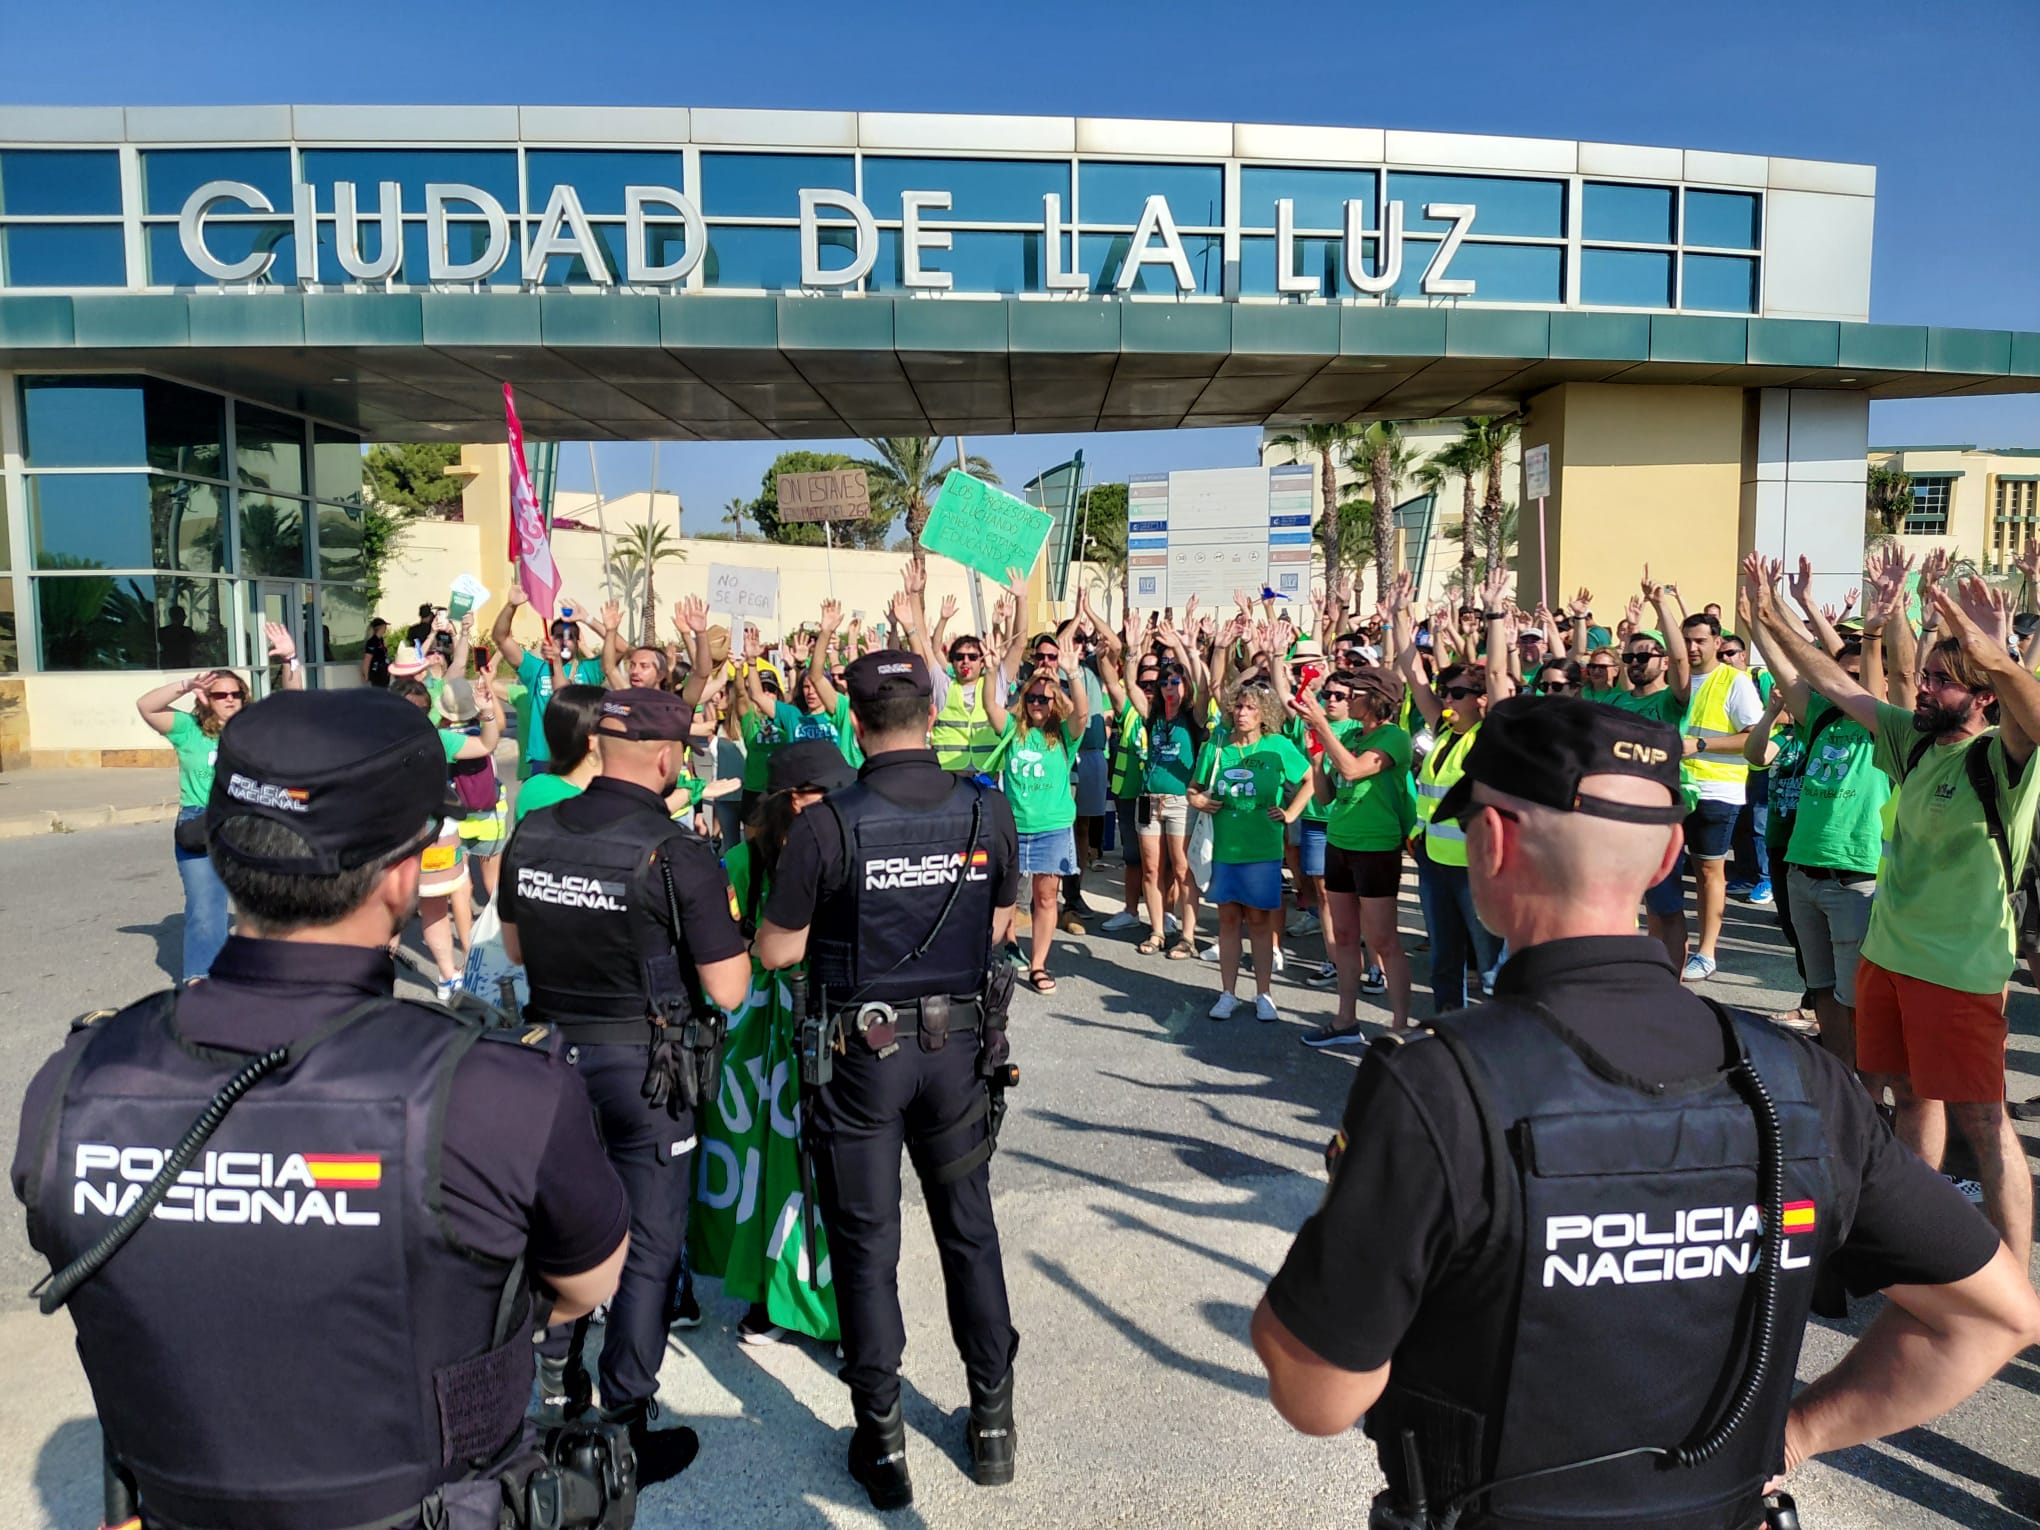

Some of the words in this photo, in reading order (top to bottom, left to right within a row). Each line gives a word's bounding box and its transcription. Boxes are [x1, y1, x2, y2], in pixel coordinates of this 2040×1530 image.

[179, 180, 708, 286] CIUDAD
[799, 188, 953, 289] DE
[1043, 192, 1197, 292] LA
[1275, 198, 1478, 295] LUZ
[948, 475, 974, 500] LOS
[717, 574, 738, 588] NO
[715, 591, 731, 605] SE
[739, 590, 769, 609] PEGA
[1613, 741, 1668, 765] CNP
[227, 784, 309, 812] NACIONAL
[230, 773, 289, 799] POLICIA
[866, 853, 964, 875] POLICIA
[518, 868, 603, 894] POLICIA
[866, 867, 988, 890] NACIONL
[1546, 1204, 1764, 1251] POLICIA
[1543, 1239, 1811, 1288] NACIONL
